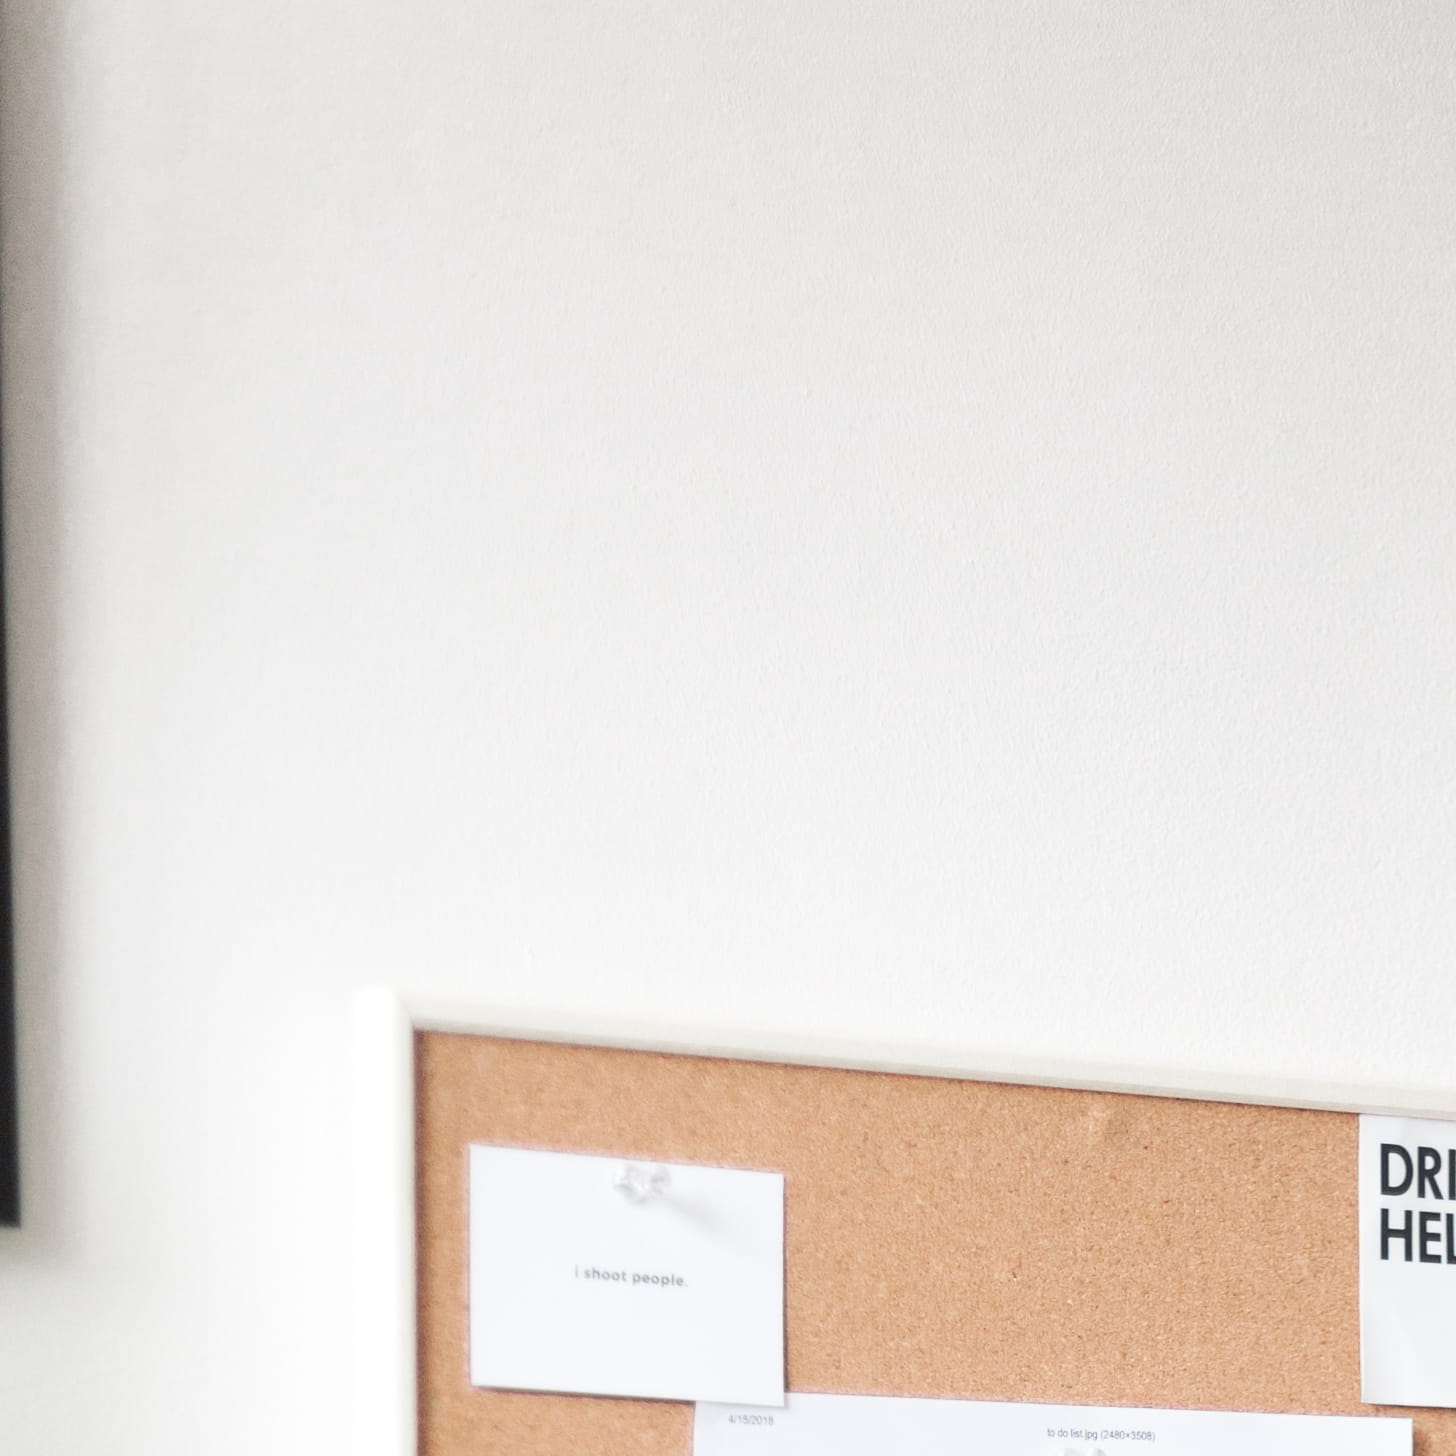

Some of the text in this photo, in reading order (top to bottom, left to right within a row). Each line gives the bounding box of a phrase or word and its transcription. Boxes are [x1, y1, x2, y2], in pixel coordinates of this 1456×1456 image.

[584, 1267, 627, 1282] shoot
[632, 1273, 688, 1287] people.
[1047, 1428, 1055, 1437] to
[1057, 1429, 1068, 1438] do
